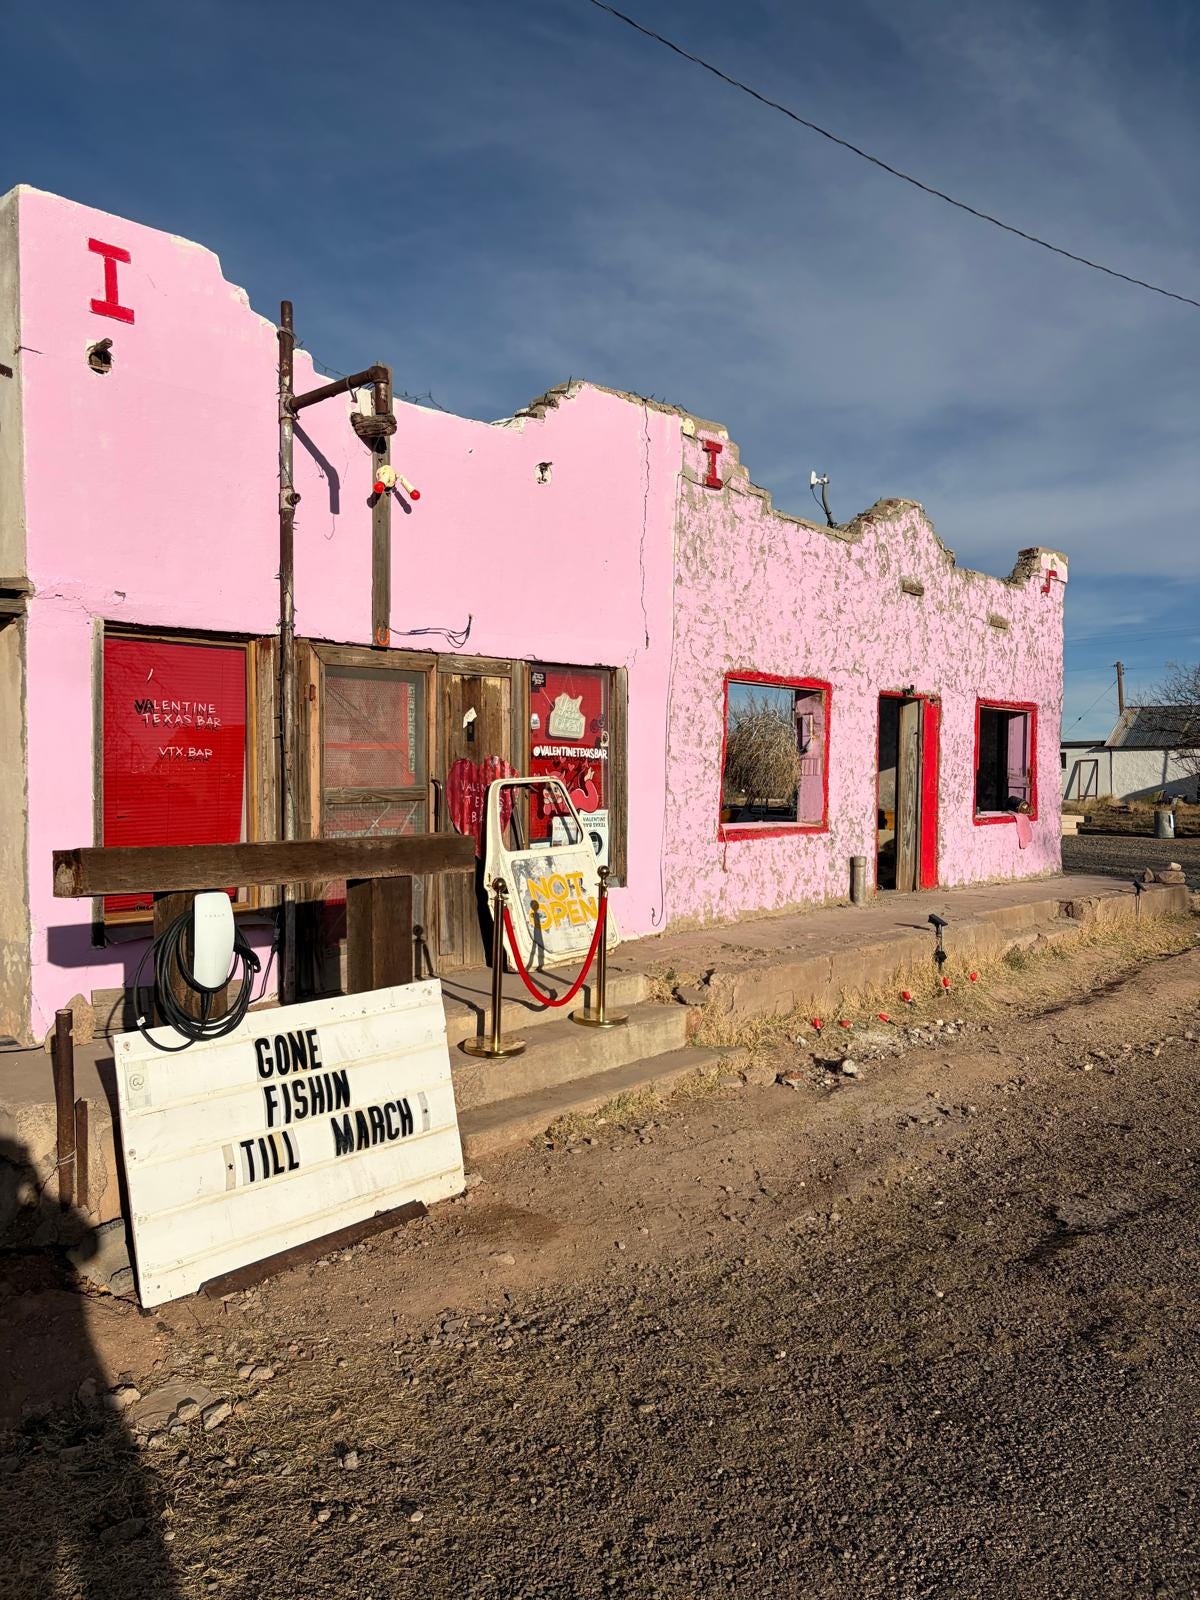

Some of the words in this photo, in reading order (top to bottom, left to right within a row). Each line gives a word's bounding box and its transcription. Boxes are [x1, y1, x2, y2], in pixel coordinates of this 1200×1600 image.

[134, 699, 217, 715] VALENTINE
[143, 713, 192, 725] TEXAS
[197, 715, 222, 727] BAR
[158, 746, 214, 758] VTX.BAR
[532, 745, 608, 760] @VALENTINETEXASBAR
[527, 872, 584, 901] NOT
[528, 896, 598, 930] OPEN
[254, 1028, 323, 1079] GONE
[263, 1069, 351, 1128] FISHIN
[239, 1130, 300, 1183] TILL
[330, 1098, 414, 1157] MARCH
